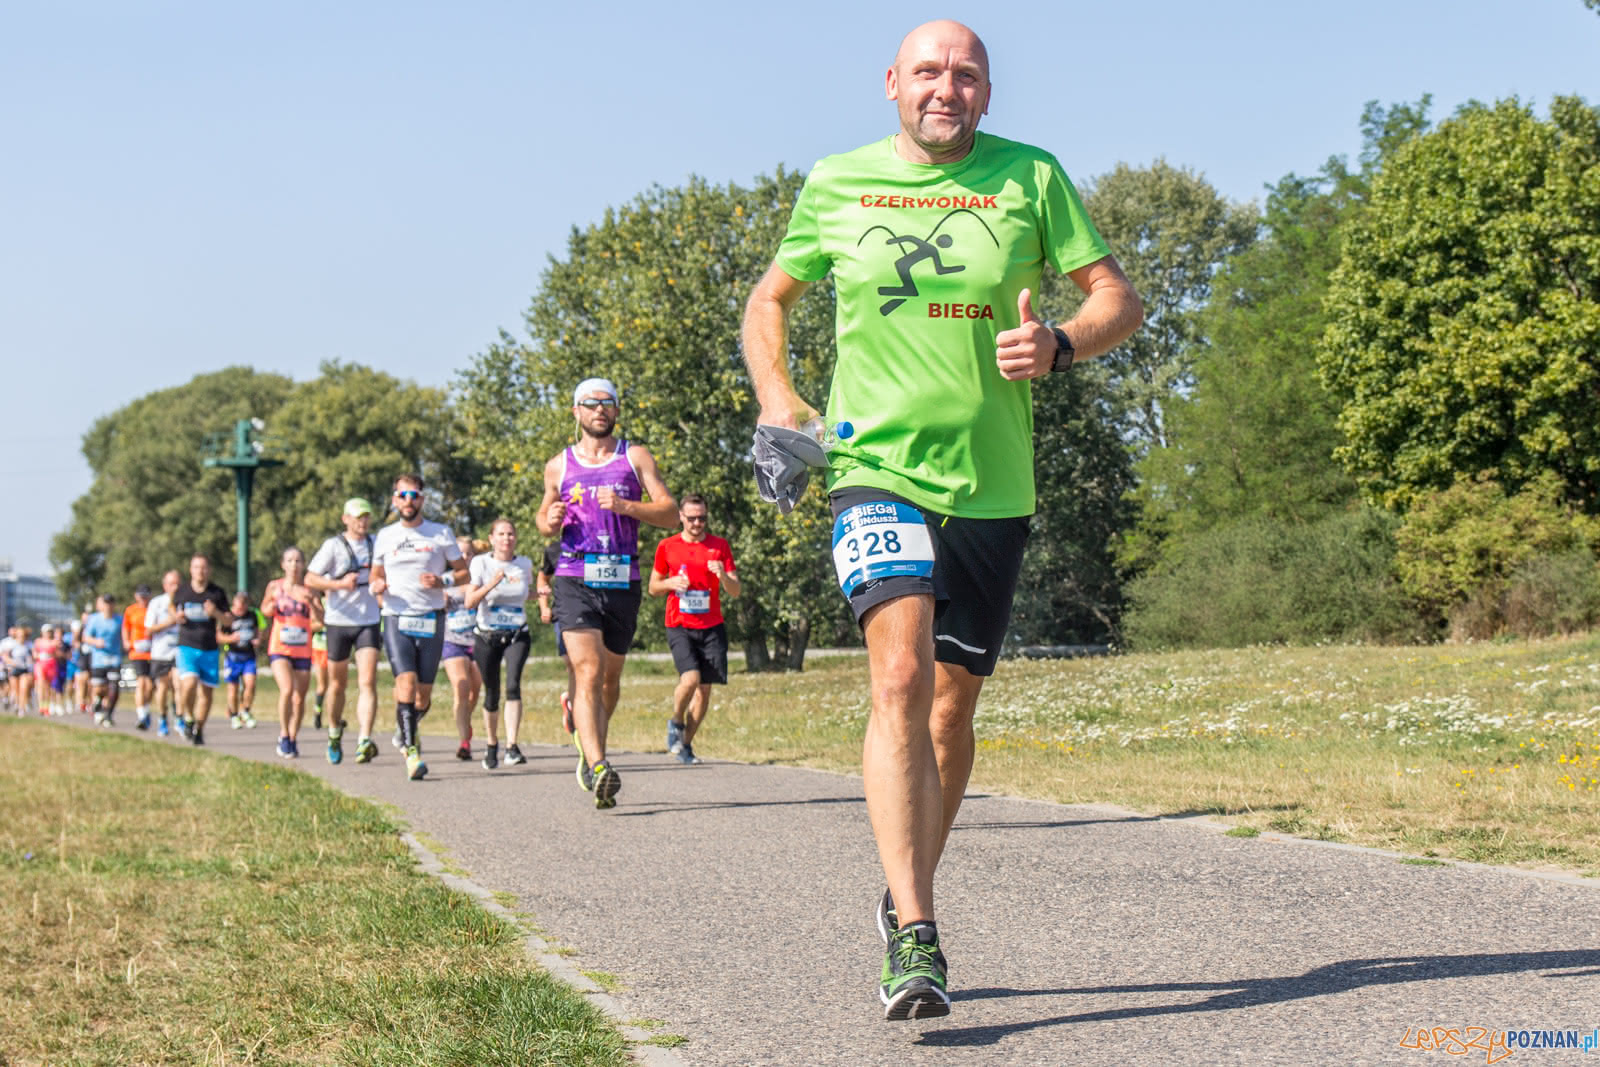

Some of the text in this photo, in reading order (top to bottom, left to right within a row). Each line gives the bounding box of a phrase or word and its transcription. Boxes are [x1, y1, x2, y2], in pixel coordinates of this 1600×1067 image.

[860, 195, 998, 209] CZERWONAK
[928, 303, 994, 320] BIEGA
[847, 530, 902, 563] 328
[596, 567, 618, 579] 154
